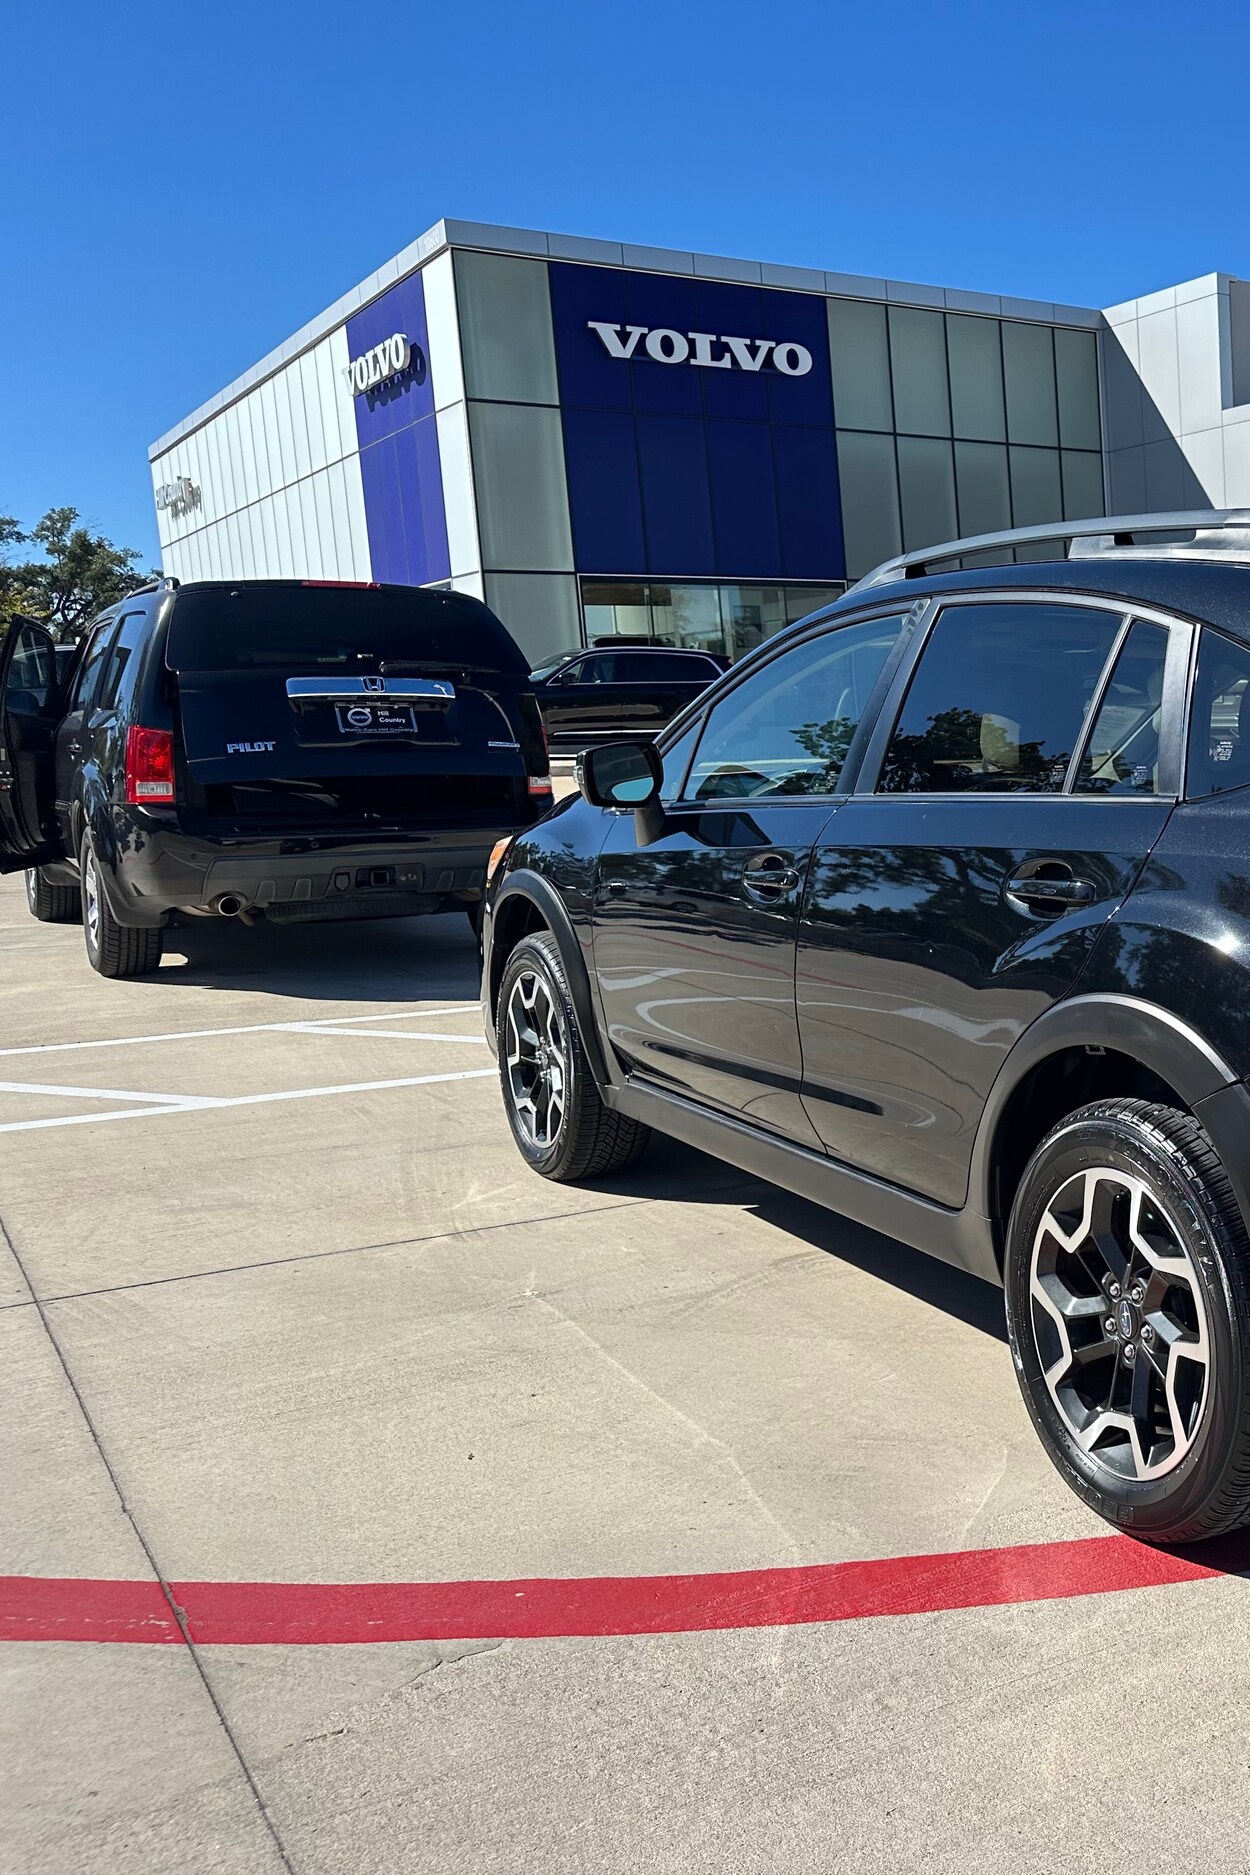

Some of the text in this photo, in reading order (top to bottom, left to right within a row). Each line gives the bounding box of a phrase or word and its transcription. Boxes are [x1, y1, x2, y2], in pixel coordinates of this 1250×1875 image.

[342, 332, 410, 397] VOLVO
[587, 320, 813, 376] VOLVO
[226, 741, 276, 754] PILOT
